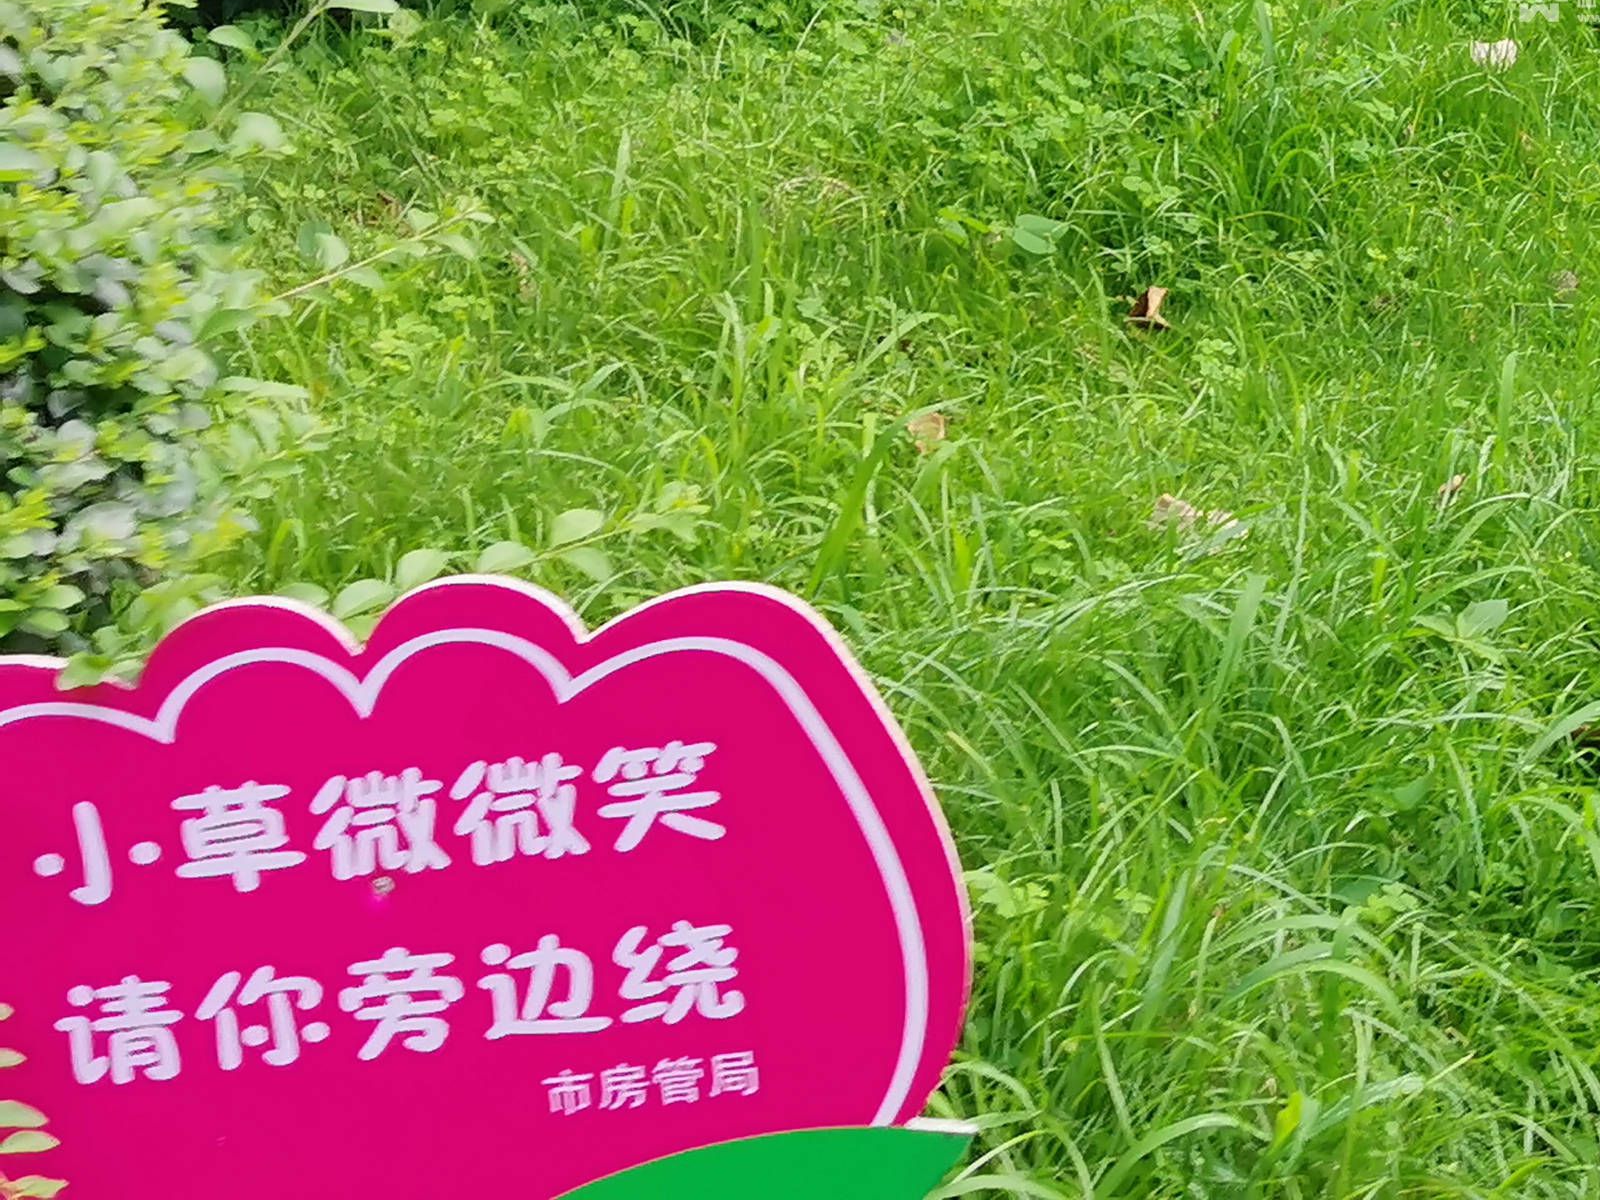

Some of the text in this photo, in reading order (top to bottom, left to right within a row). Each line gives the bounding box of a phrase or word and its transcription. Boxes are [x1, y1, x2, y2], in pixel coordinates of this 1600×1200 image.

[35, 741, 726, 904] 小草微微笑
[55, 921, 745, 1085] 请你旁边绕
[542, 1050, 759, 1115] 市房管局
